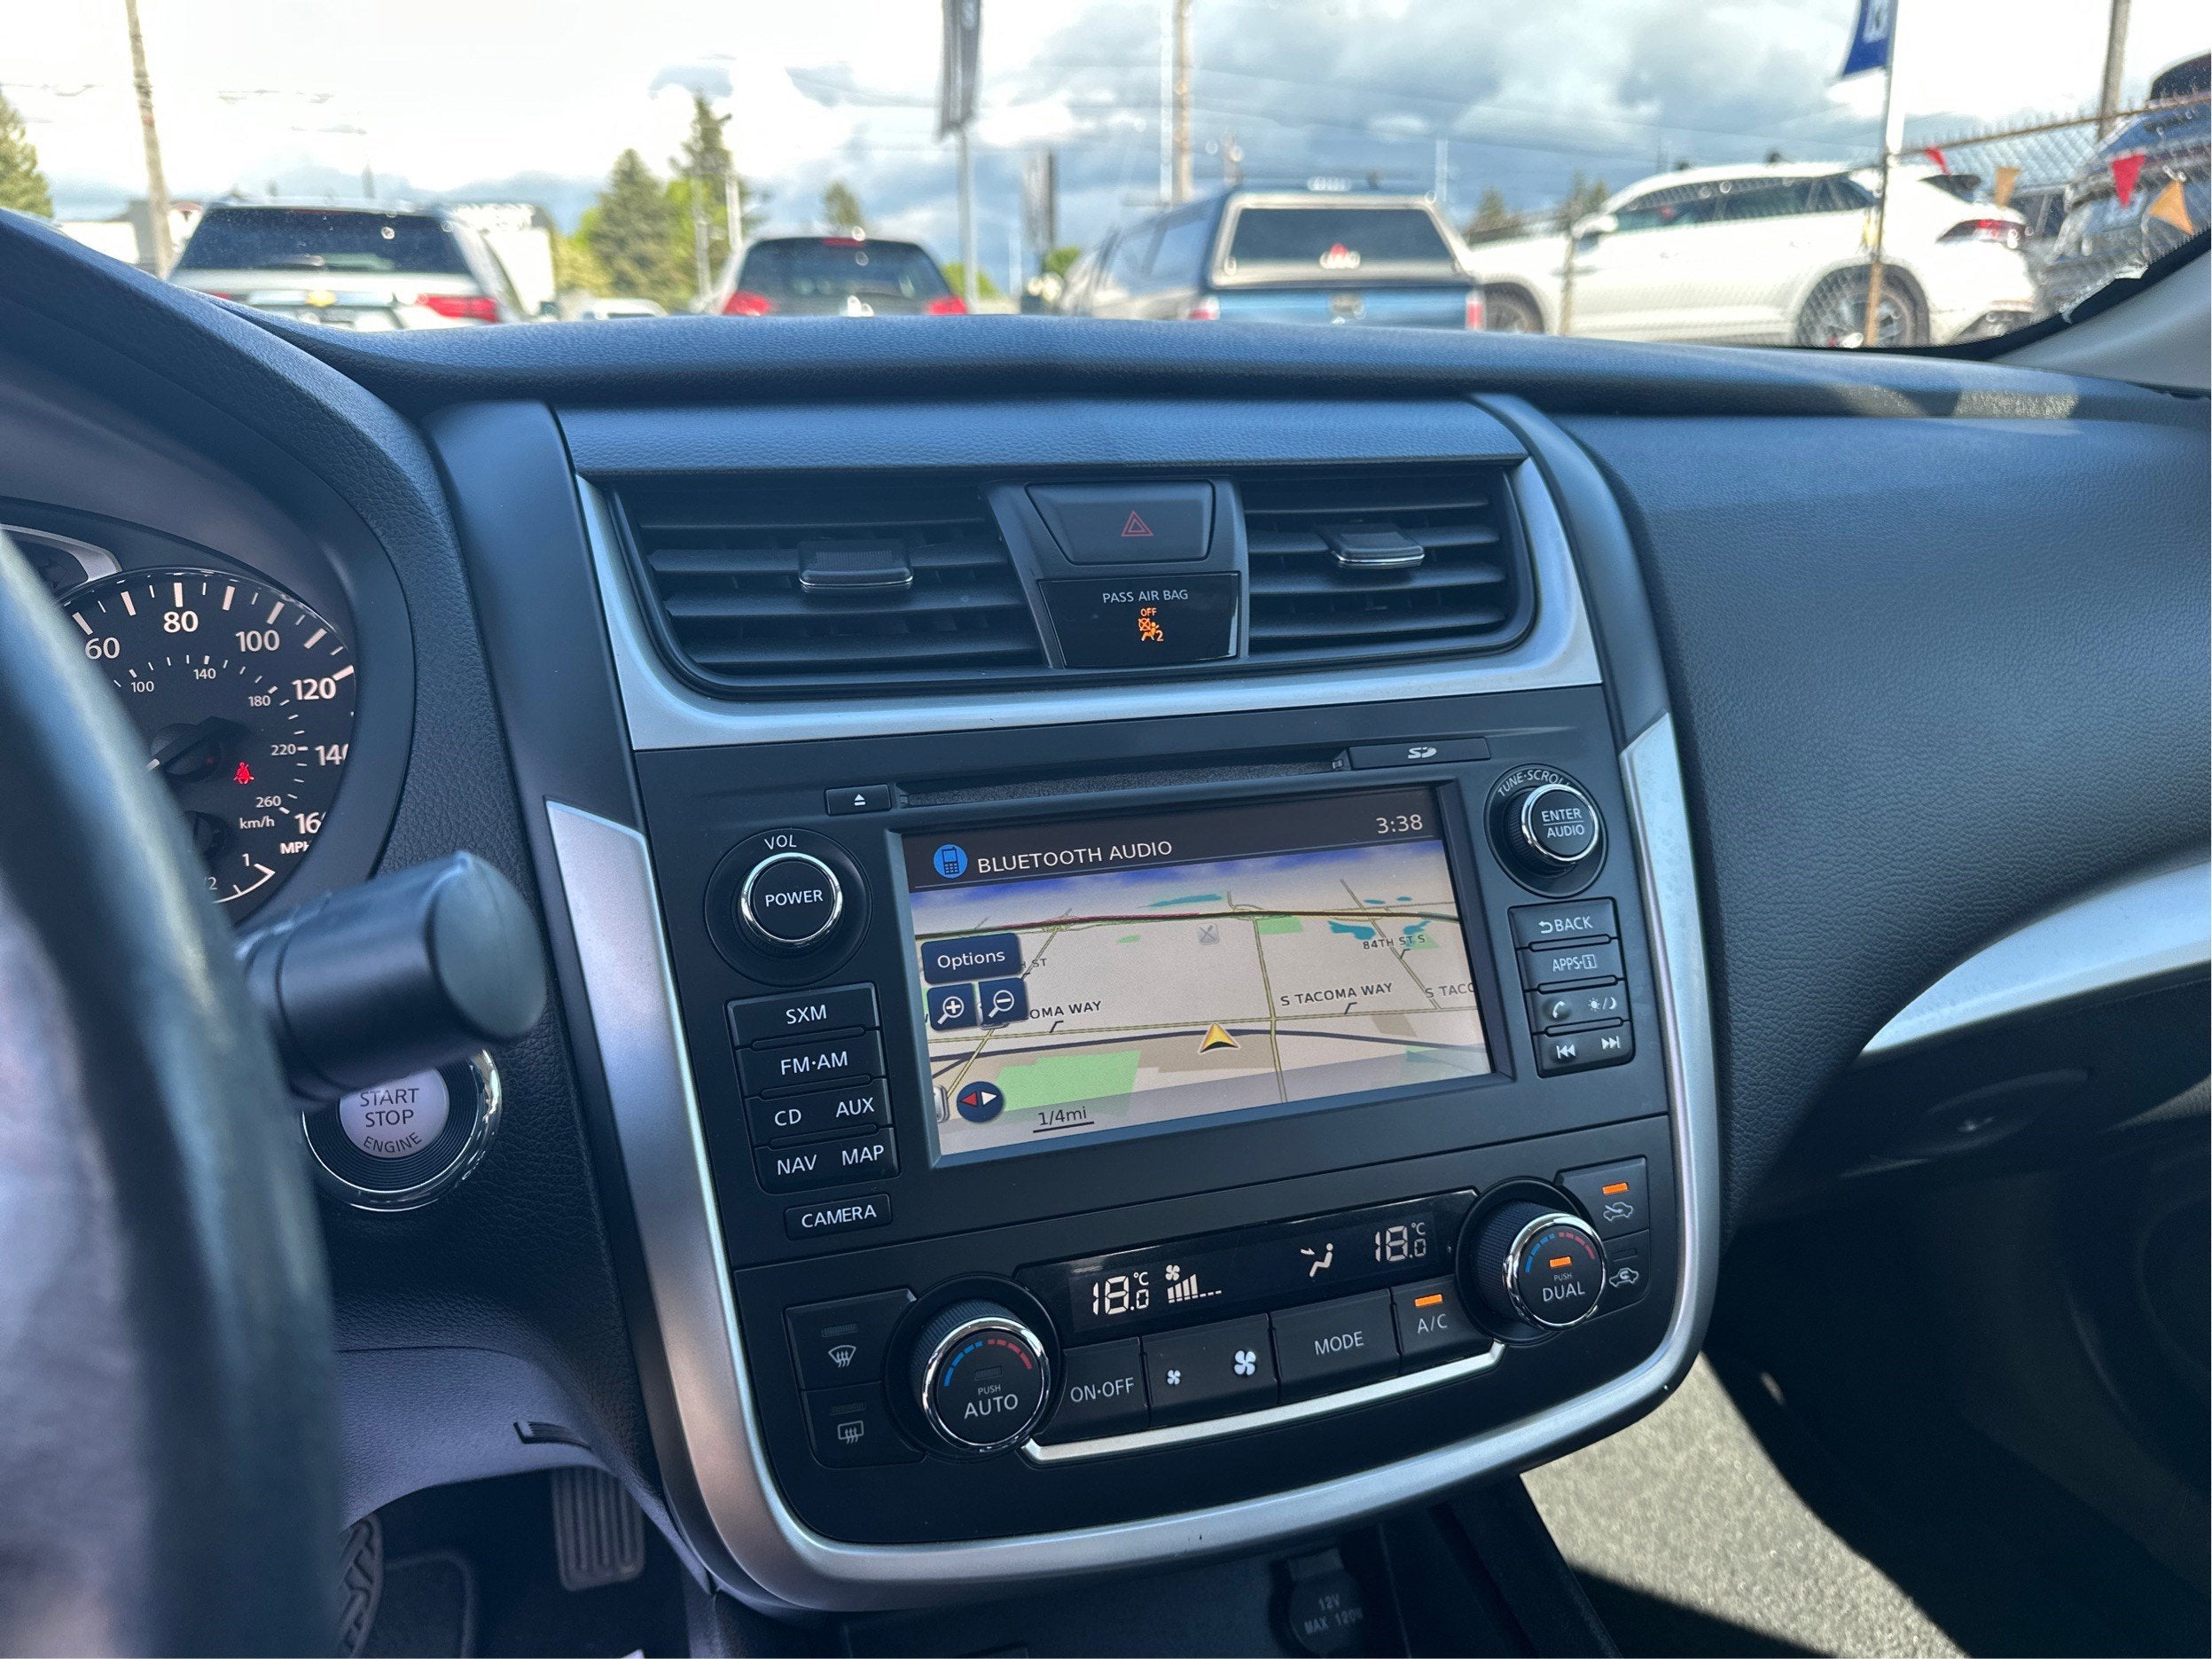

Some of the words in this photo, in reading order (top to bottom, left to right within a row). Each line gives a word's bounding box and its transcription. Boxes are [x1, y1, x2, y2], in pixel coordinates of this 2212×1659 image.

[1103, 591, 1134, 604] PASS
[1137, 590, 1160, 602] AIR
[1163, 589, 1189, 601] BAG
[163, 610, 199, 633] 80
[1140, 607, 1158, 617] OFF
[84, 637, 121, 660] 60
[236, 630, 280, 652] 100
[193, 668, 216, 680] 140
[130, 680, 154, 693] 100
[292, 677, 337, 700] 120
[248, 695, 271, 708] 180
[270, 744, 296, 756] 220
[315, 743, 349, 766] 14
[255, 795, 282, 809] 260
[239, 816, 275, 830] km/h
[294, 811, 327, 834] 16
[1375, 814, 1423, 834] 3:38
[1541, 808, 1583, 822] ENTER
[1546, 825, 1585, 838] AUDIO
[764, 834, 797, 850] VOL
[242, 853, 250, 867] 1
[977, 846, 1103, 874] BLUETOOTH
[1108, 841, 1172, 862] AUDIO
[765, 889, 824, 907] POWER
[1554, 915, 1593, 932] BACK
[1363, 938, 1394, 950] 84TH
[1399, 935, 1413, 946] ST
[1418, 934, 1426, 943] S
[937, 950, 1006, 971] Options
[1032, 958, 1047, 968] ST
[1281, 995, 1290, 1006] S
[1295, 987, 1357, 1005] TACOMA
[1360, 982, 1393, 996] WAY
[1425, 987, 1434, 998] S
[786, 1004, 827, 1025] SXM
[1068, 1000, 1102, 1014] WAY
[360, 1088, 419, 1107] START
[365, 1109, 414, 1128] STOP
[774, 1108, 802, 1127] CD
[835, 1097, 875, 1118] AUX
[1038, 1106, 1087, 1126] 1/4mi
[363, 1132, 423, 1153] ENGINE
[777, 1154, 817, 1176] NAV
[841, 1144, 884, 1166] MAP
[801, 1204, 877, 1229] CAMERA
[1553, 1272, 1573, 1282] PUSH
[1541, 1281, 1586, 1303] DUAL
[1417, 1313, 1448, 1334] A/C
[1314, 1331, 1364, 1357] MODE
[977, 1383, 1001, 1397] PUSH
[964, 1394, 1020, 1420] AUTO
[1317, 1593, 1341, 1611] 12V
[1303, 1616, 1329, 1635] MAX
